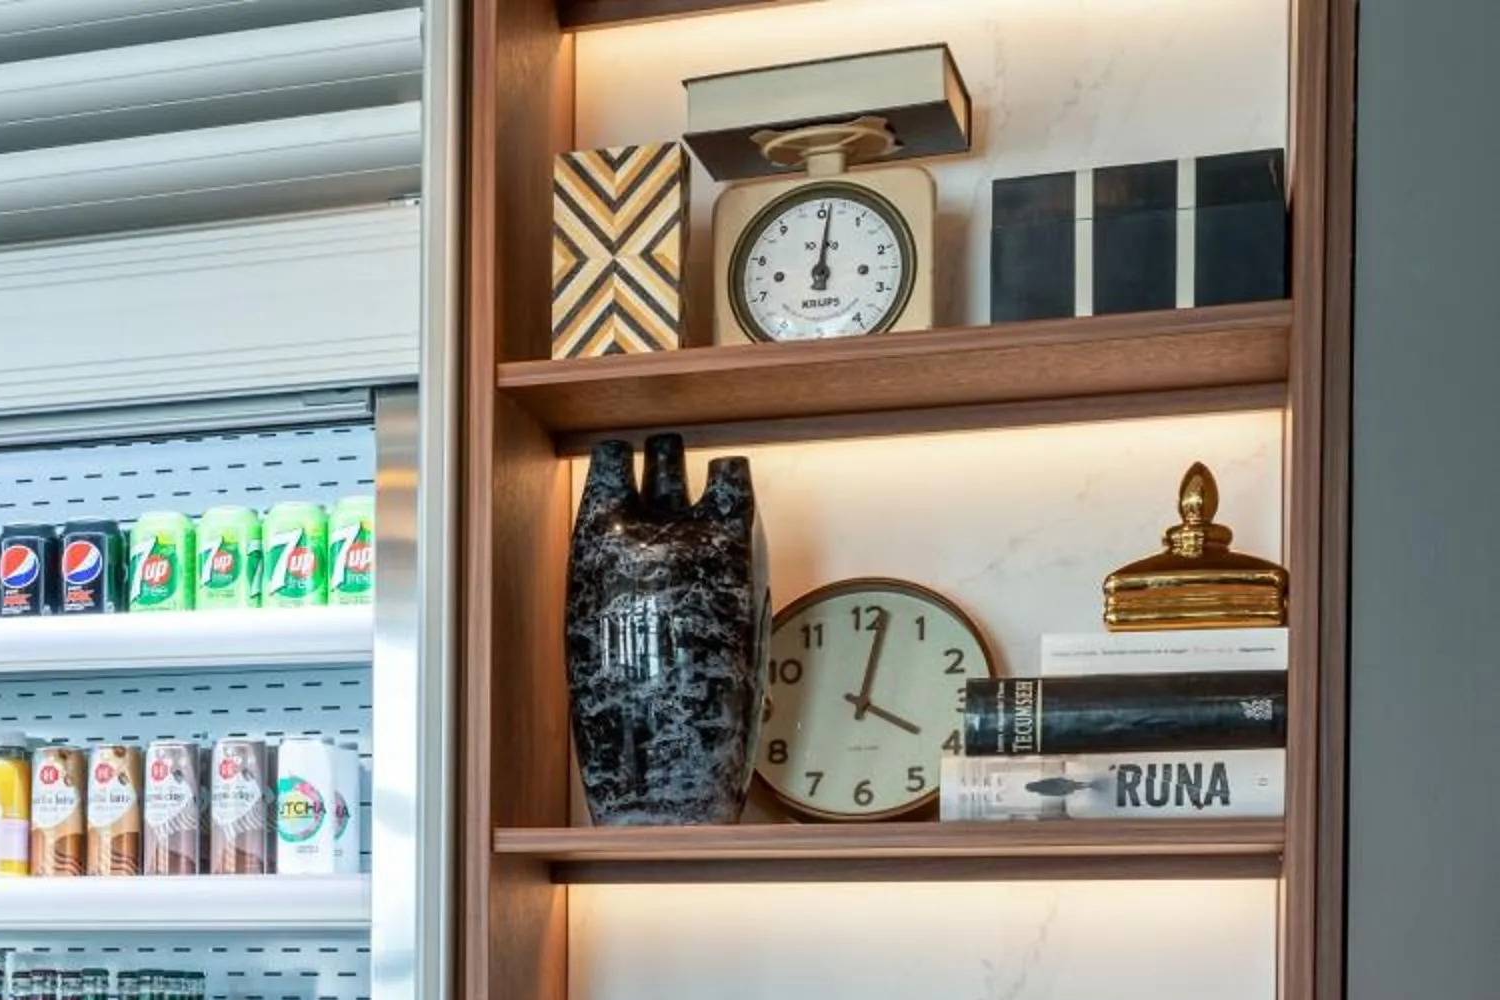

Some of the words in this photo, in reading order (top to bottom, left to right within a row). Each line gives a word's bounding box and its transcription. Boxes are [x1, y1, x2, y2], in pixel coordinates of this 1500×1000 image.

[877, 244, 886, 254] 2
[759, 292, 767, 301] 7
[876, 282, 885, 292] 3
[802, 298, 841, 309] KRUPS
[852, 312, 861, 322] 4
[851, 605, 884, 631] 12
[915, 616, 925, 641] 1
[801, 623, 823, 649] 11
[769, 659, 802, 685] 10
[943, 648, 966, 674] 2
[768, 739, 788, 765] 8
[941, 730, 963, 755] 4
[805, 771, 824, 796] 7
[906, 767, 925, 792] 5
[1116, 761, 1231, 808] RUNA
[853, 780, 874, 806] 6
